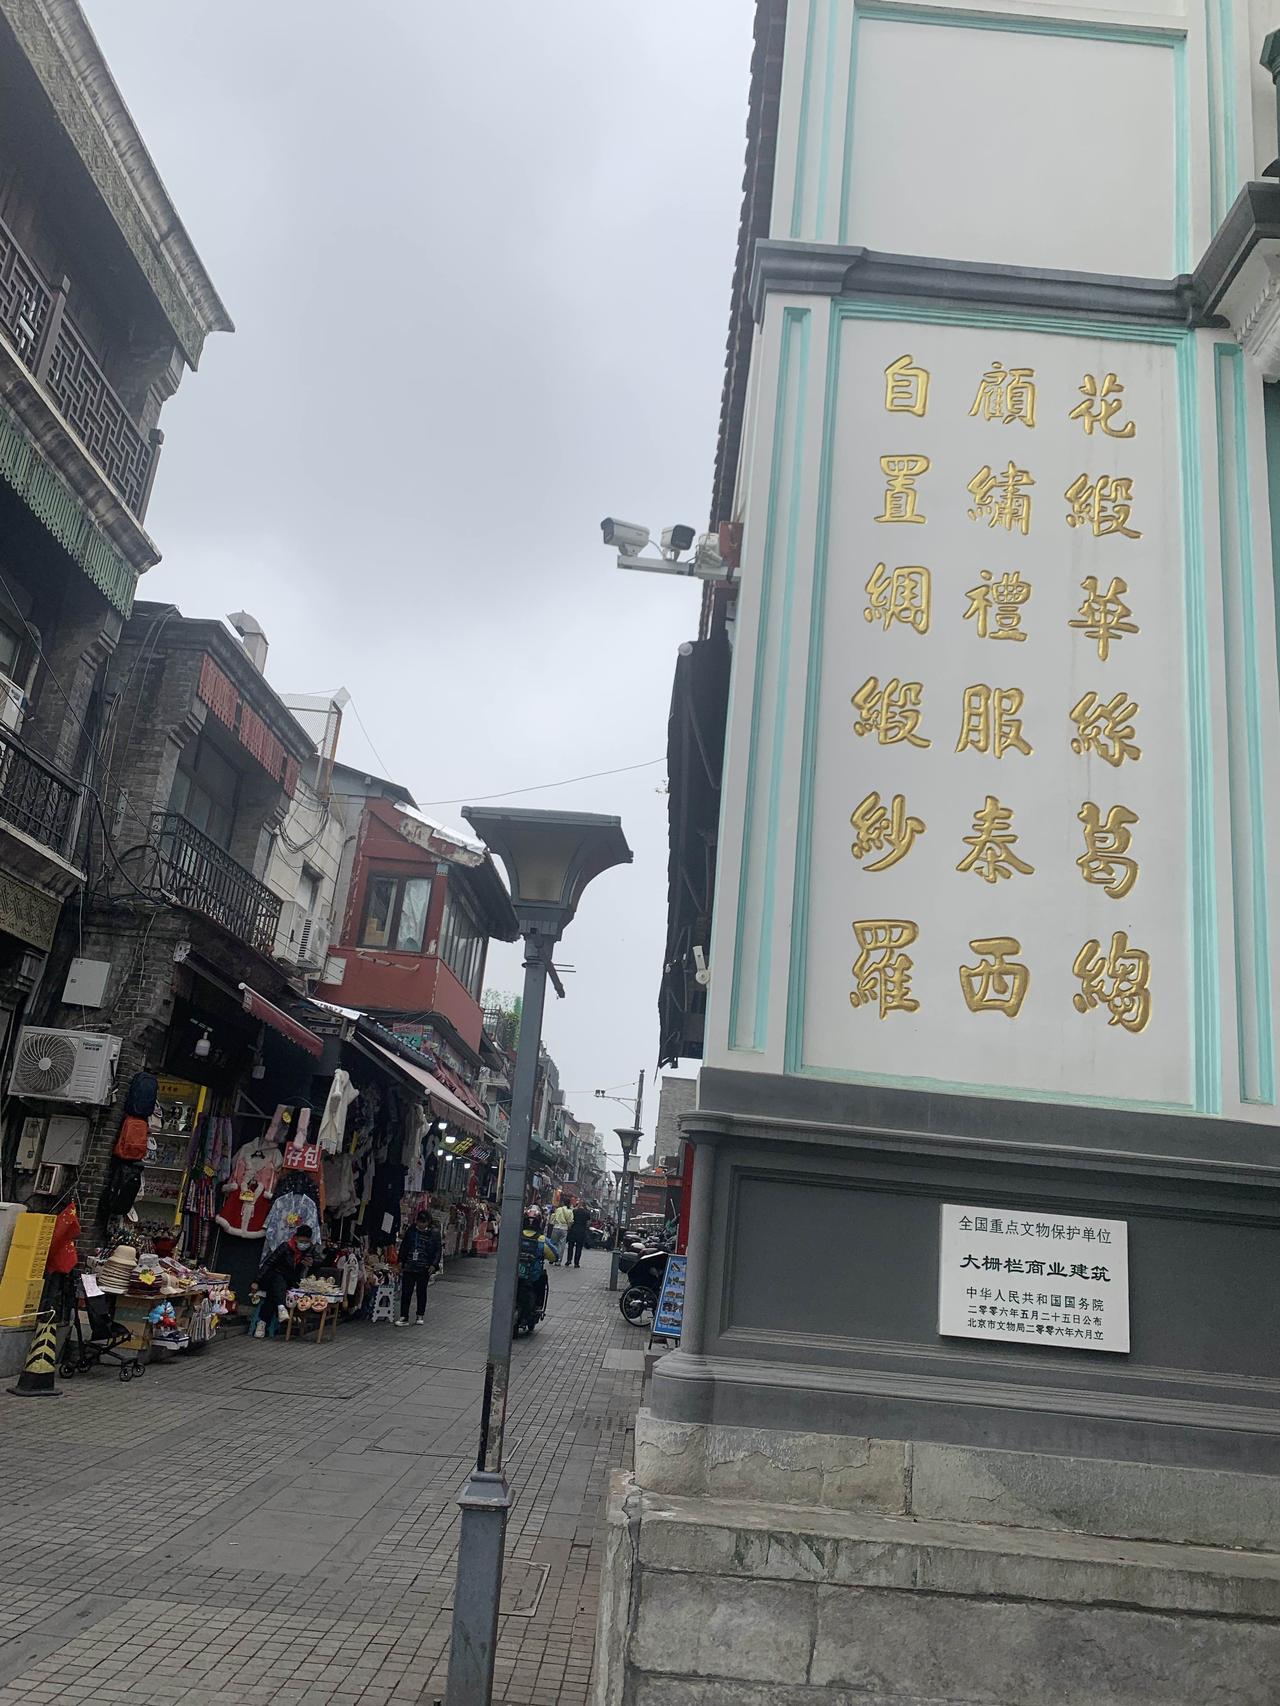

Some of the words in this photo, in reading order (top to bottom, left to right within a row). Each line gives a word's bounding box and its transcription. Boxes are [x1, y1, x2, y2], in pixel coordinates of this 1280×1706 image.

[849, 353, 932, 1021] 自置綢緞紗羅
[955, 361, 1038, 1020] 顧繡禮服泰西
[959, 1215, 1112, 1244] 全国重点文物保护单位
[959, 1254, 1111, 1282] 大栅栏商业建筑
[966, 1286, 1104, 1312] 中华人民共和国国务院
[967, 1304, 1103, 1326] 二零零六年五月二十五日公布
[967, 1317, 1104, 1341] 北京市文物局二零零六年六月立
